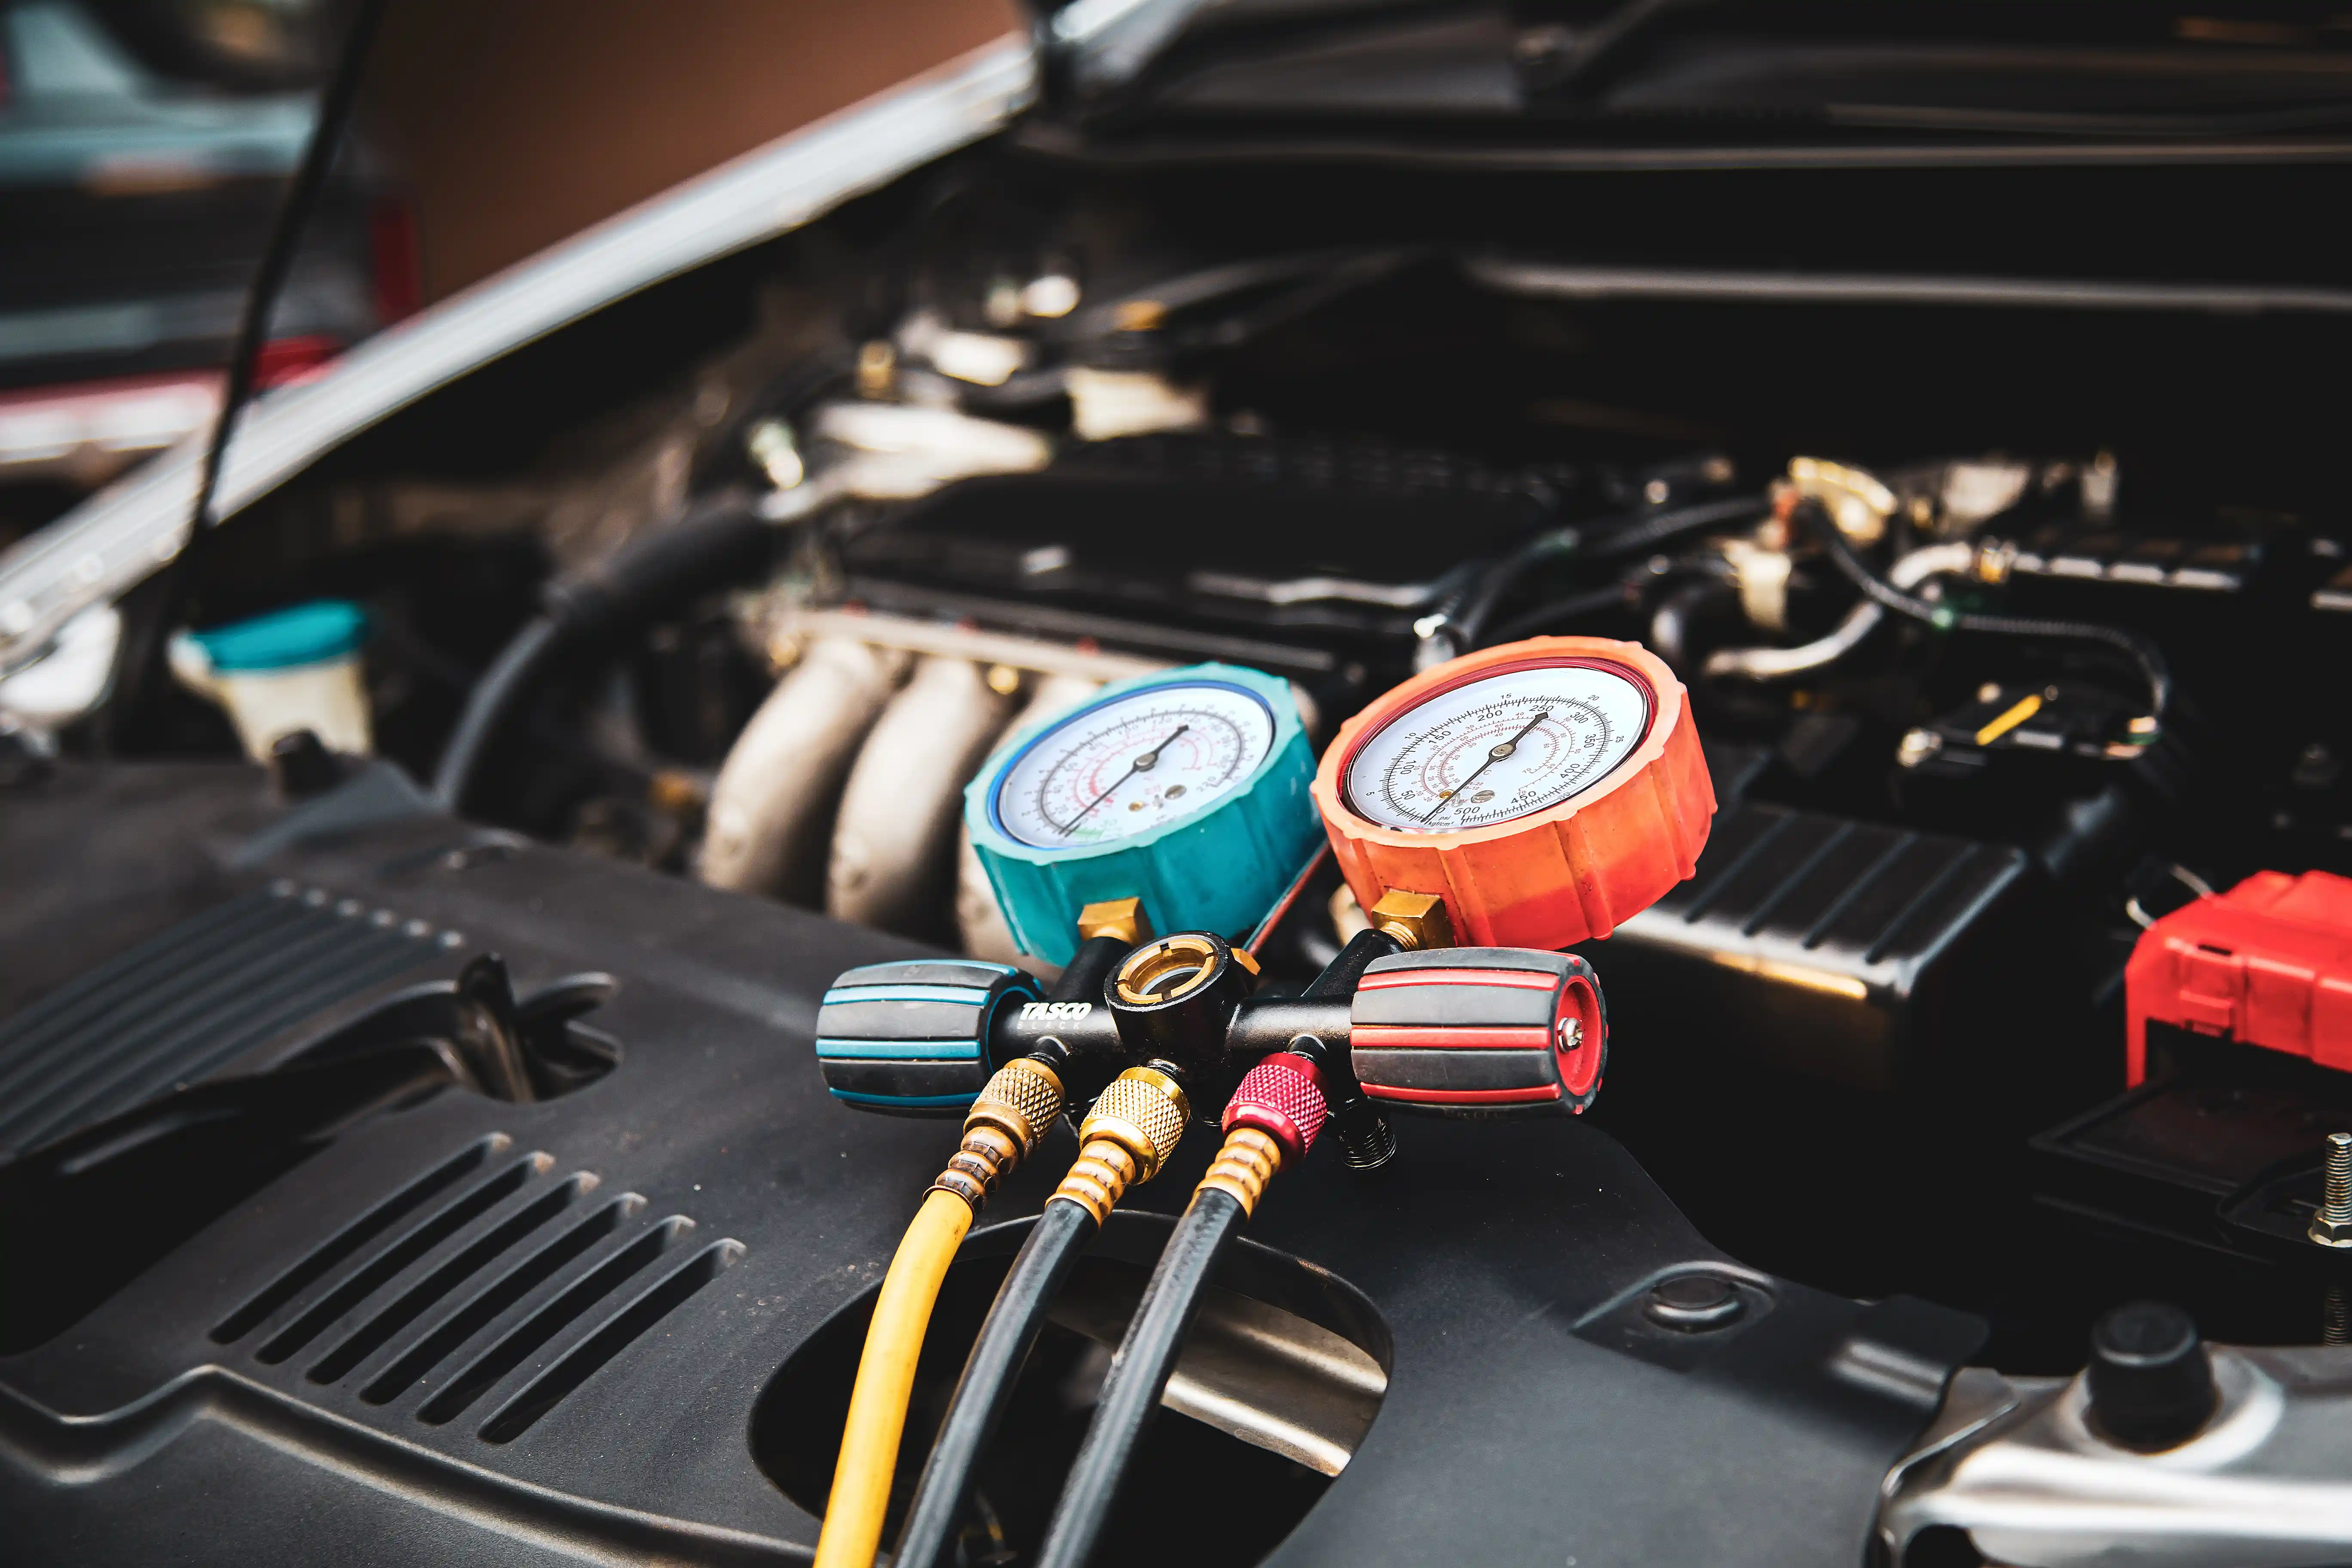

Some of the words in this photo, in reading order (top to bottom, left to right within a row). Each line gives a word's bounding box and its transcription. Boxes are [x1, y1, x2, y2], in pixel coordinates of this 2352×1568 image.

[1477, 710, 1502, 722] 200
[1570, 712, 1588, 723] 300
[1428, 731, 1451, 744] 150
[1584, 734, 1596, 748] 350
[1400, 760, 1417, 774] 100
[1560, 764, 1580, 778] 400
[1401, 790, 1415, 800] 50
[1511, 791, 1536, 803] 450
[1454, 806, 1480, 815] 500
[1020, 1002, 1092, 1020] TASCO
[1017, 1021, 1080, 1030] BLACK
